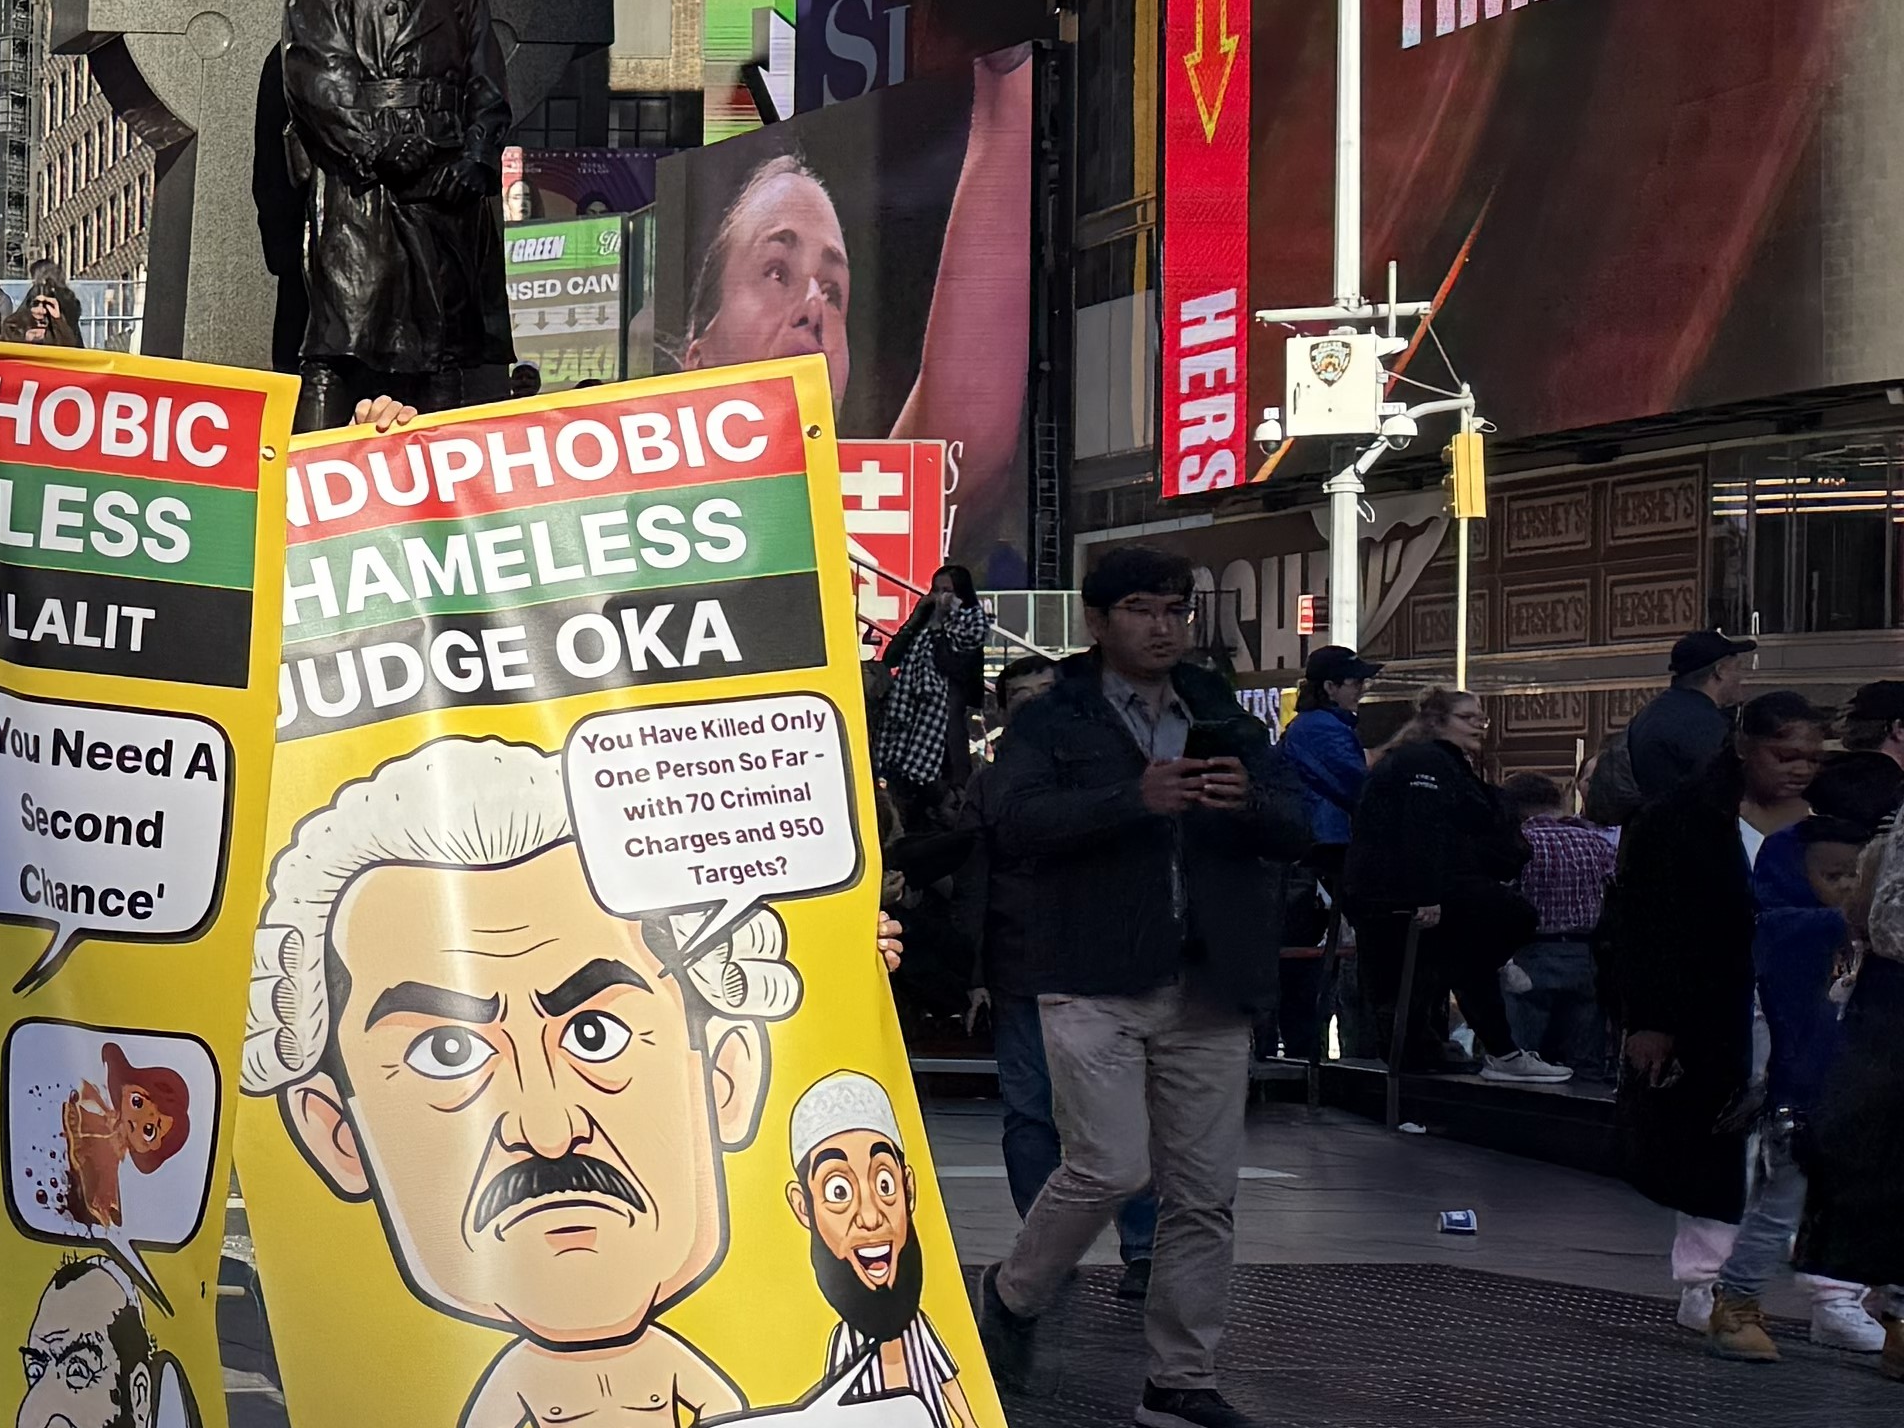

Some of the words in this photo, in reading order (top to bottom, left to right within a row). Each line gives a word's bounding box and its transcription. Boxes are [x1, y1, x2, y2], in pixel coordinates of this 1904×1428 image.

[512, 235, 565, 262] GREEN
[1509, 492, 1589, 543] HERSHEY'S
[282, 499, 747, 626] HAMELESS
[556, 599, 742, 679] OKA
[1509, 591, 1587, 638] HERSHEY'S
[52, 729, 173, 776] Need
[185, 742, 217, 781] A
[21, 792, 163, 849] Second
[19, 863, 165, 920] Chance'
